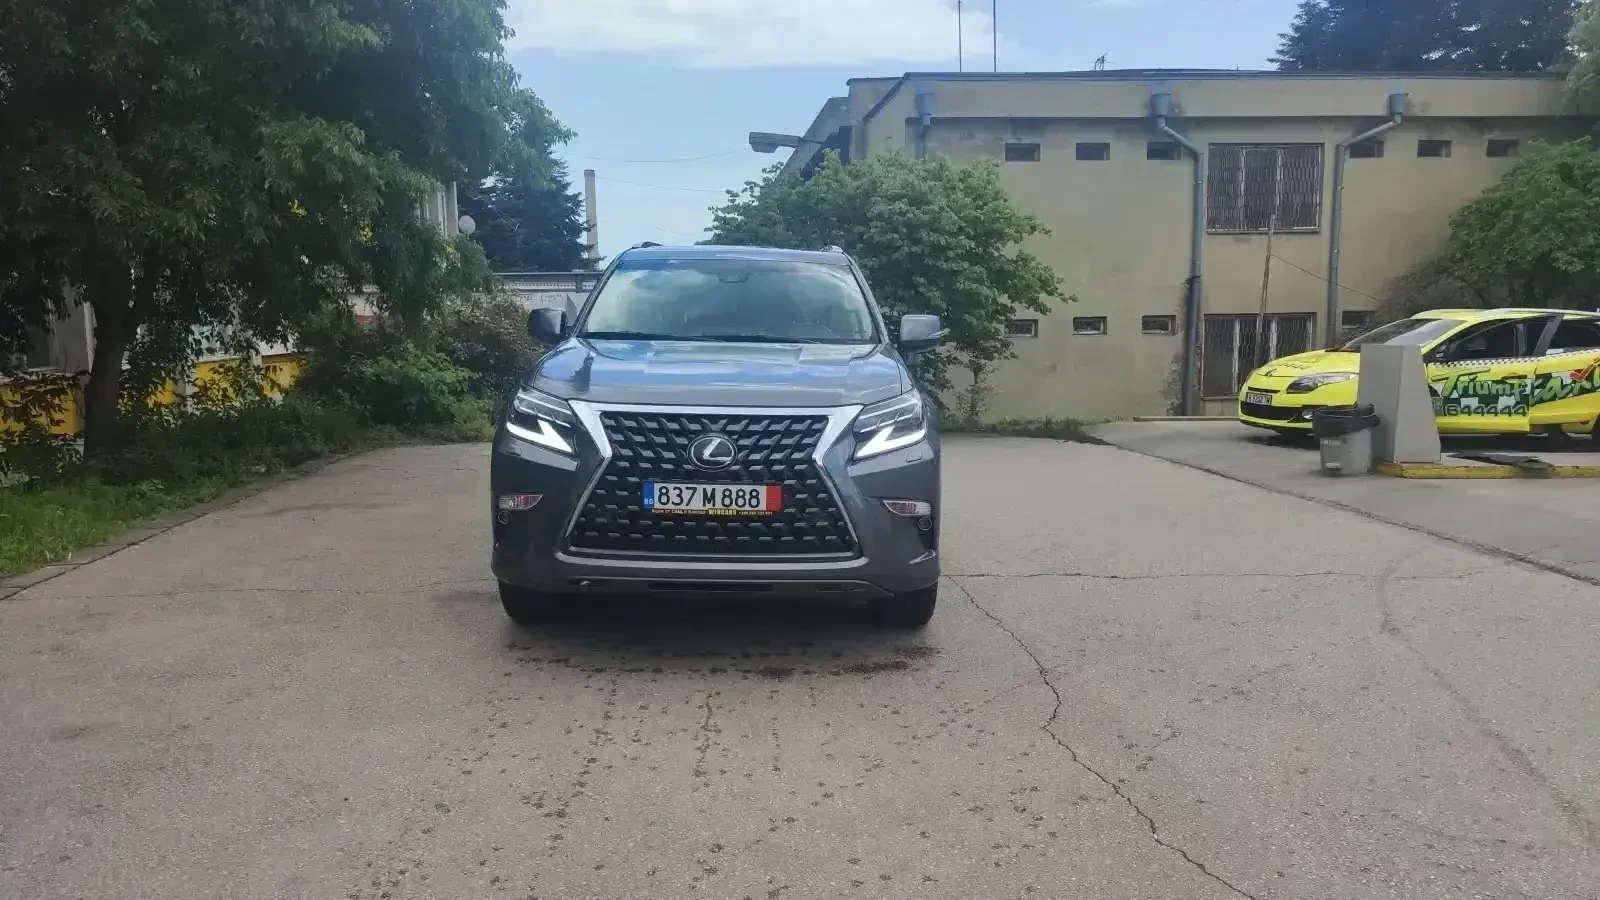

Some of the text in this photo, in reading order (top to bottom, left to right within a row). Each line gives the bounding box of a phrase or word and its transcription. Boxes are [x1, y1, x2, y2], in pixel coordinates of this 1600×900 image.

[1445, 404, 1528, 416] 644444
[657, 485, 698, 507] 837
[702, 487, 716, 508] M
[721, 488, 761, 509] 888
